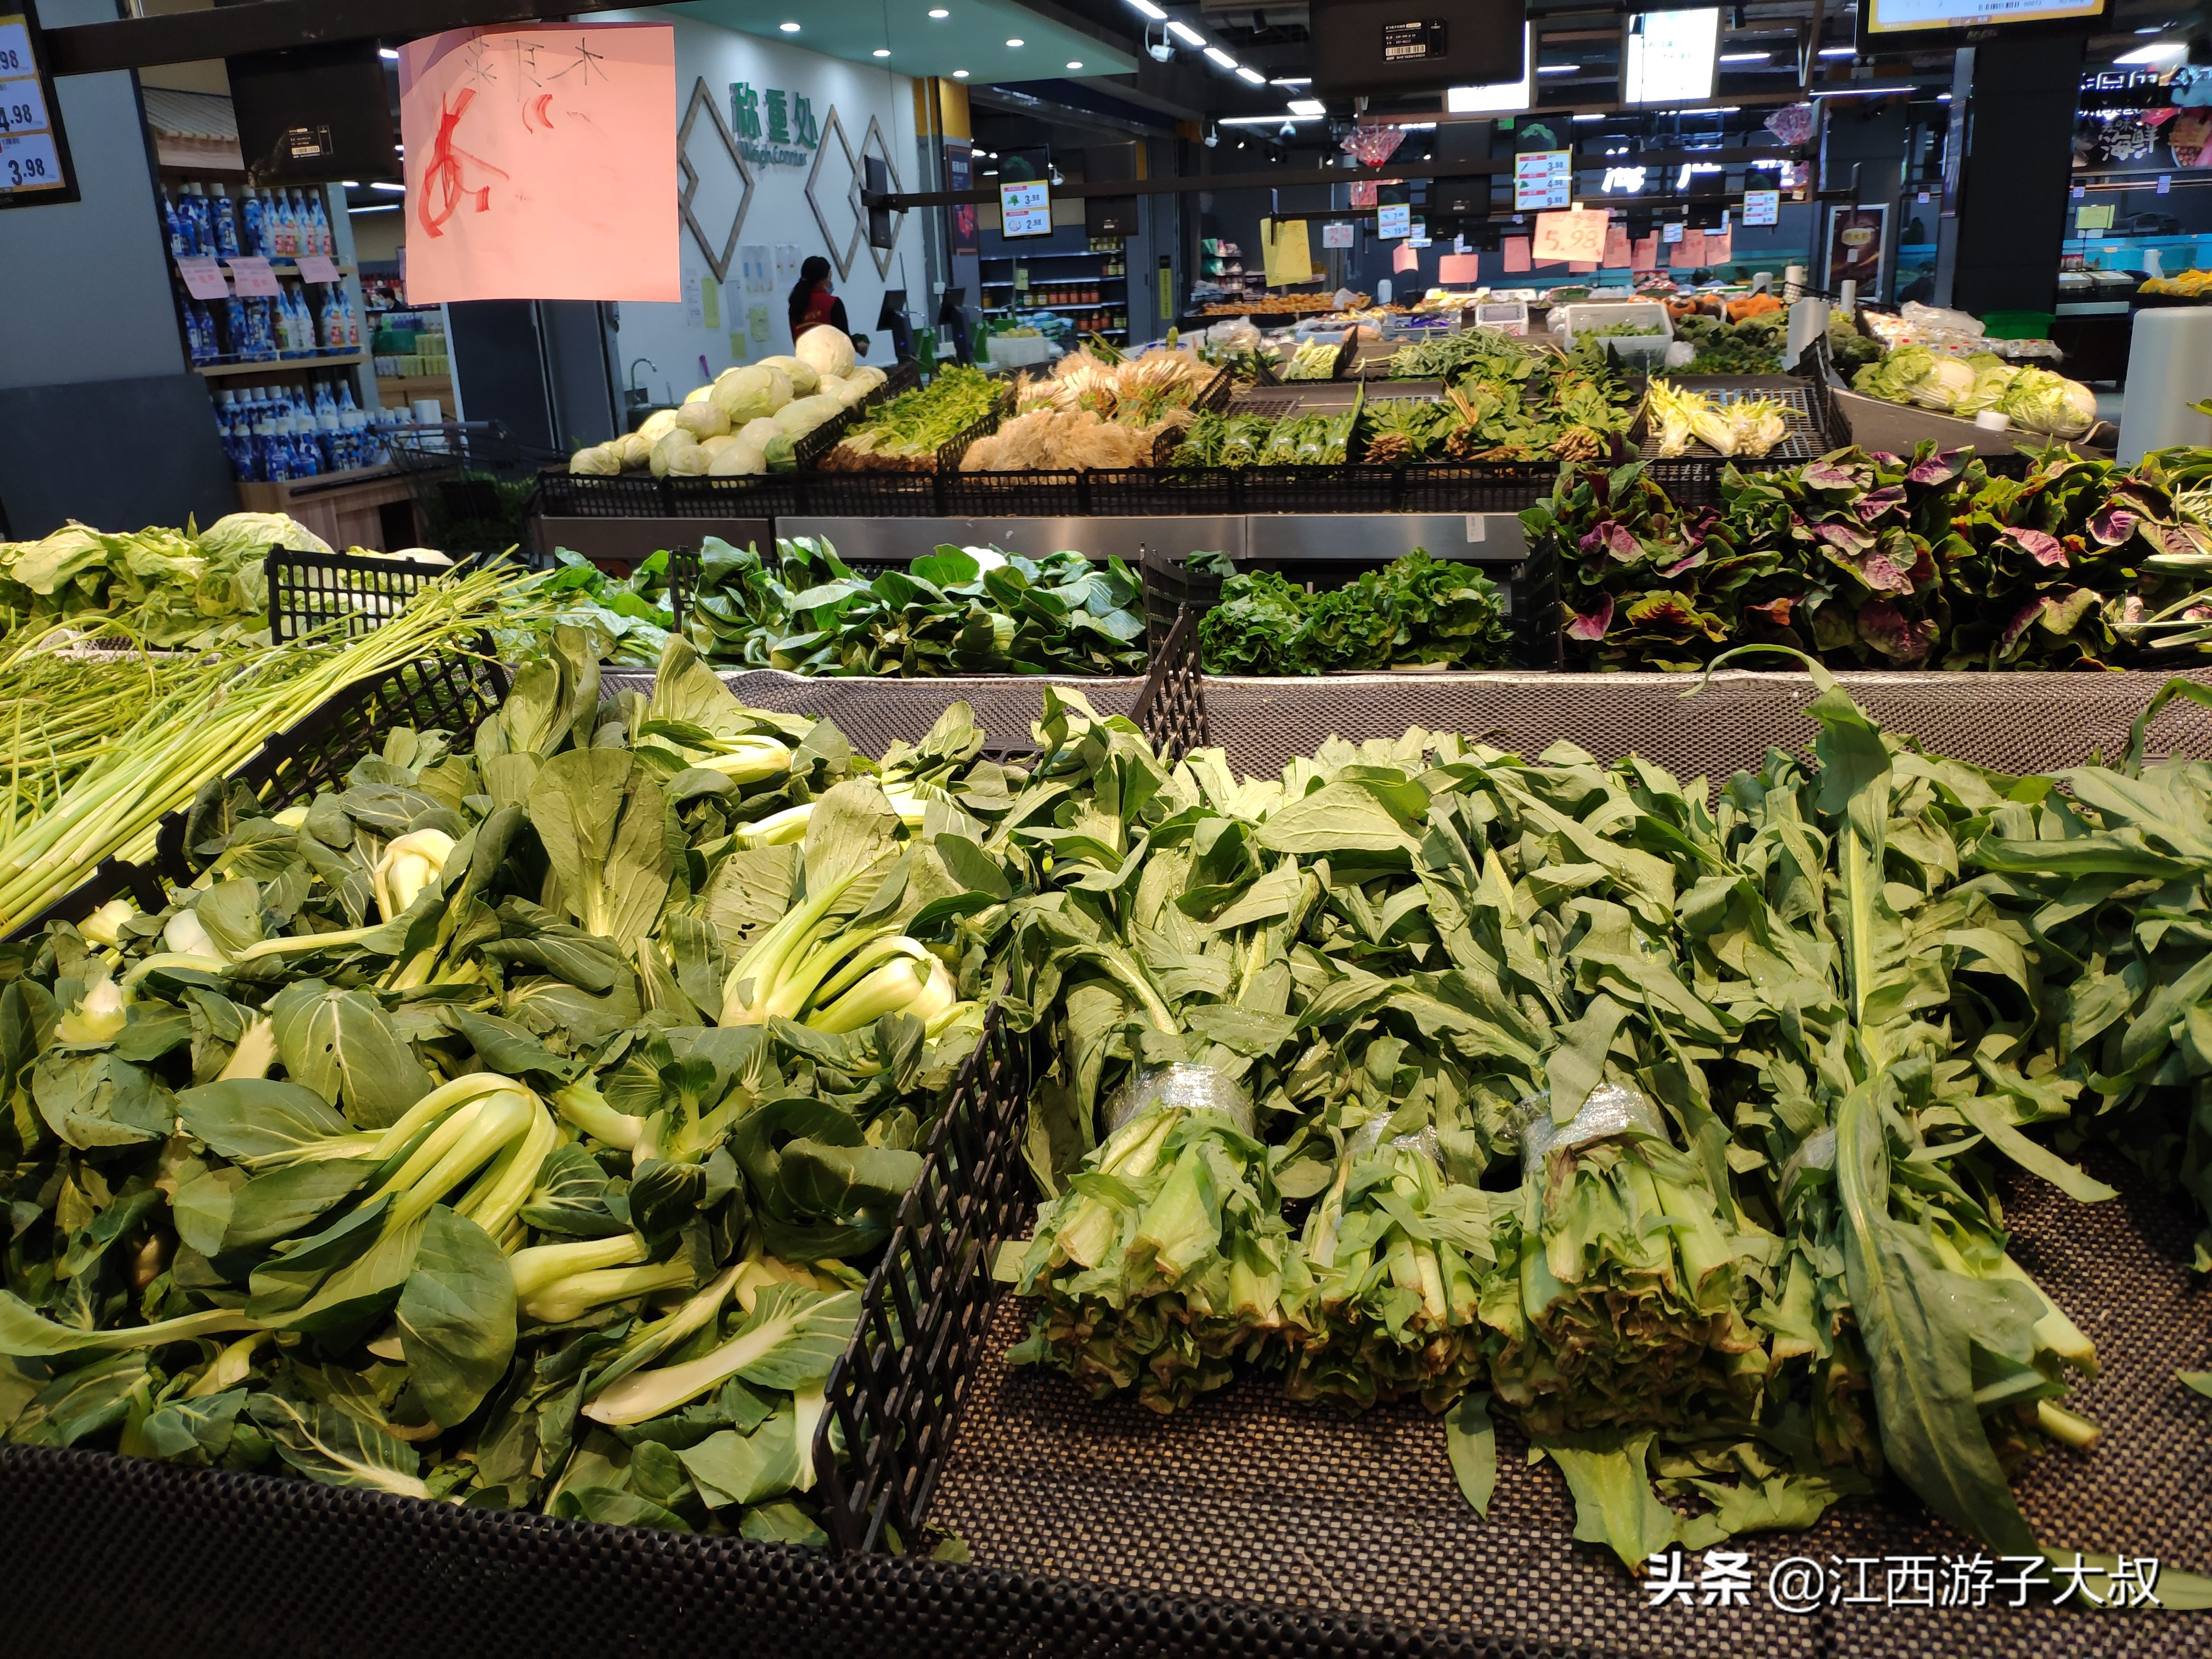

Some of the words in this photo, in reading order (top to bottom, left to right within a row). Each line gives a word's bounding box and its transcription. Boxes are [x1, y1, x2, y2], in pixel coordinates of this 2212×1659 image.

[0, 104, 32, 132] 4.98
[730, 82, 818, 149] 称重处
[8, 158, 44, 185] 3.98
[1545, 229, 1599, 251] 5.98
